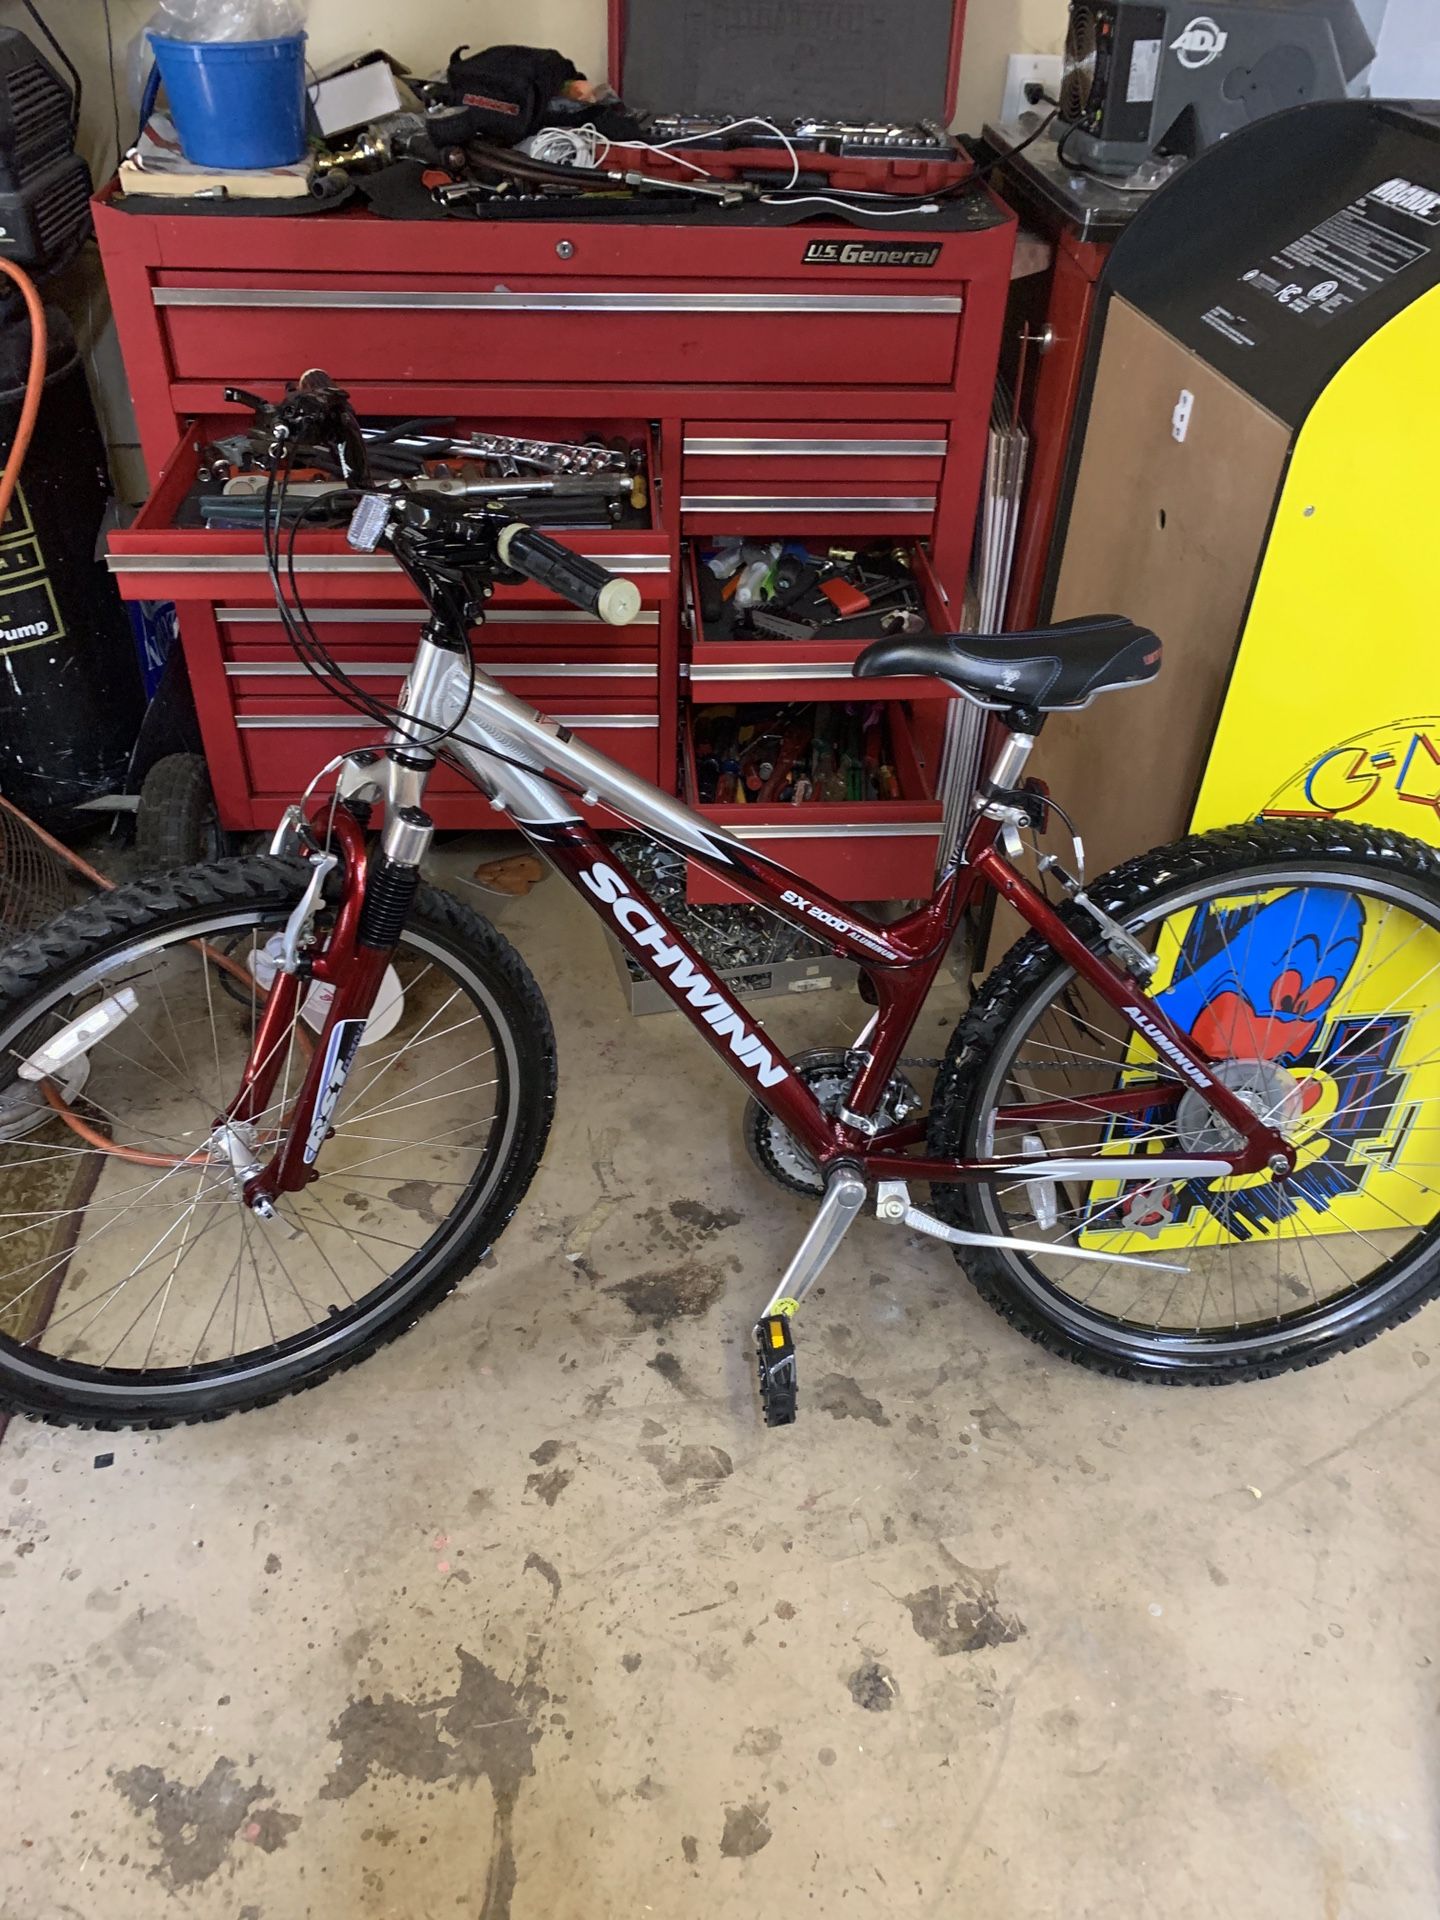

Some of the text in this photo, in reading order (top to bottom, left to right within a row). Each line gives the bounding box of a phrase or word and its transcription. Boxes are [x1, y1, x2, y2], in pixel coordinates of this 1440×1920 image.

[1169, 30, 1228, 52] ADJ
[1373, 178, 1440, 216] ARCADE
[839, 244, 939, 265] General
[780, 889, 899, 961] SX 2000 ALUMINUM
[578, 862, 789, 1088] SCHWINN
[1121, 1006, 1214, 1088] ALUMINUM
